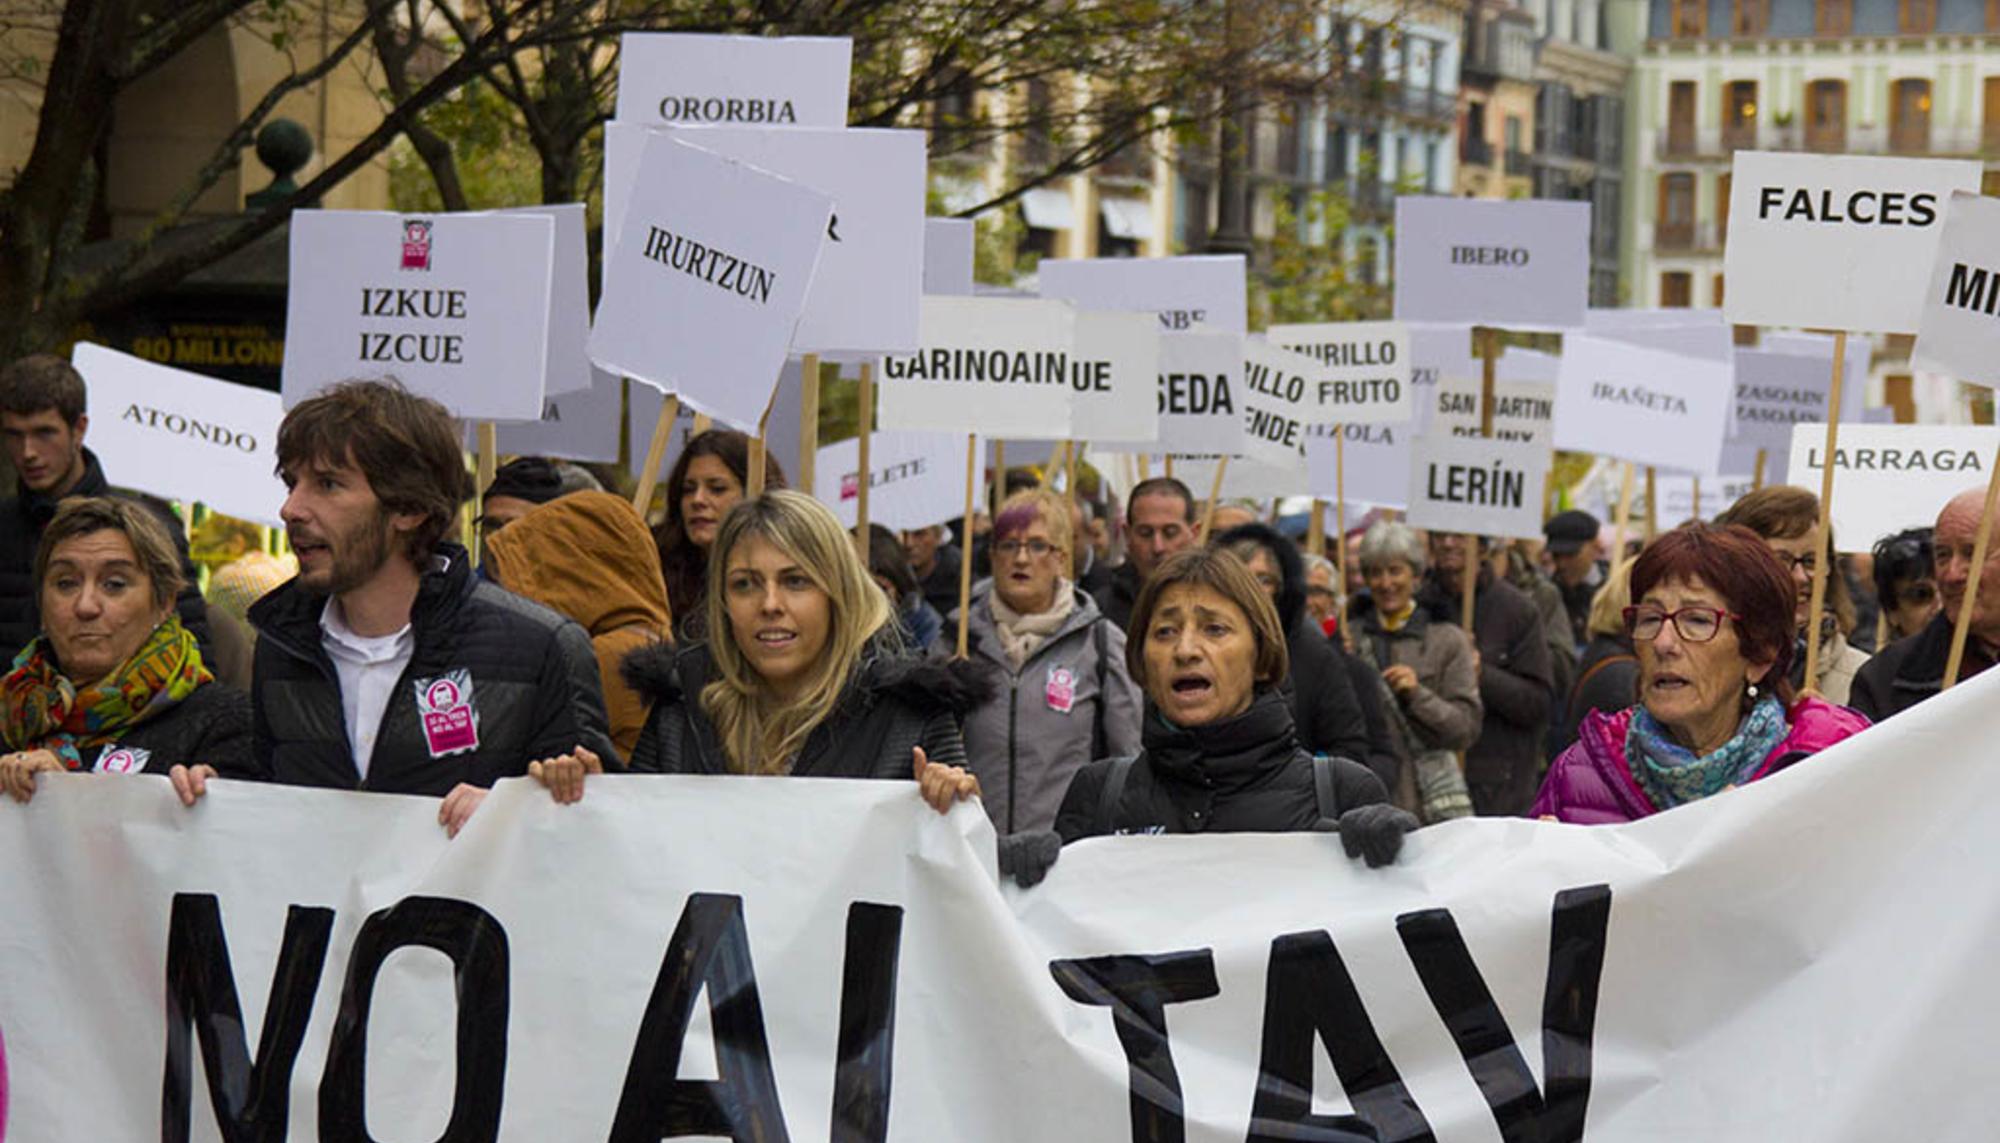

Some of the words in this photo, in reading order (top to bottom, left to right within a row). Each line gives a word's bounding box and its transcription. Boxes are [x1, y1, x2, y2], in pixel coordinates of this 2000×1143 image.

[660, 97, 797, 123] ORORBIA
[1758, 187, 1938, 226] FALCES
[643, 225, 776, 304] IRURTZUN
[1450, 246, 1530, 267] IBERO
[360, 287, 468, 319] IZKUE
[1945, 262, 2000, 317] MI
[359, 332, 464, 363] IZCUE
[1282, 340, 1397, 367] RILLO
[885, 348, 1067, 384] GARINOAIN
[1318, 378, 1401, 405] FRUTO
[1439, 391, 1476, 415] SAN
[1492, 395, 1552, 420] ARTIN
[122, 403, 257, 452] ATONDO
[1807, 448, 1982, 472] LARRAGA
[1427, 459, 1524, 509] LERÍN
[161, 891, 511, 1143] NO
[1048, 882, 1613, 1143] TAV
